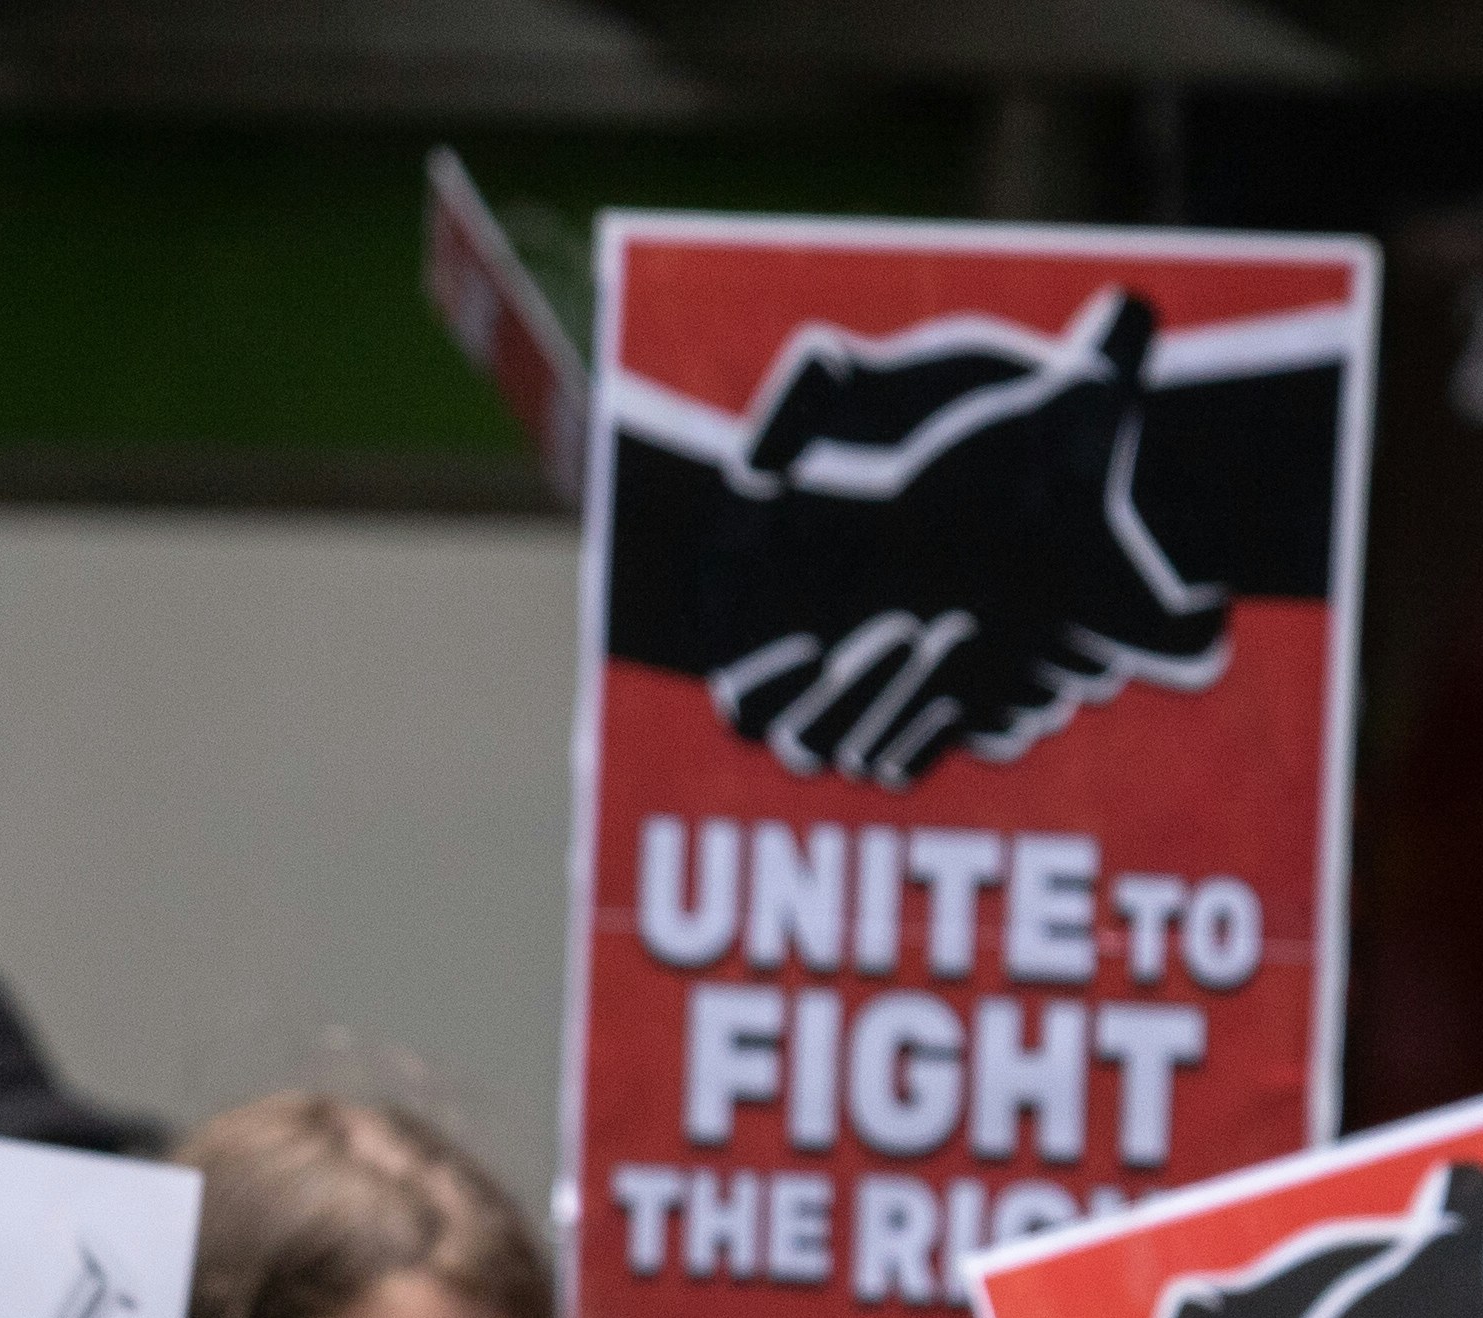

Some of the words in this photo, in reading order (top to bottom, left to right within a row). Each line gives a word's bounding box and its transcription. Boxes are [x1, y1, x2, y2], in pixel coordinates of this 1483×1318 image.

[638, 817, 1098, 978] UNITE
[1114, 876, 1261, 984] TO
[685, 984, 1205, 1163] FIGHT
[613, 1165, 832, 1279] THE
